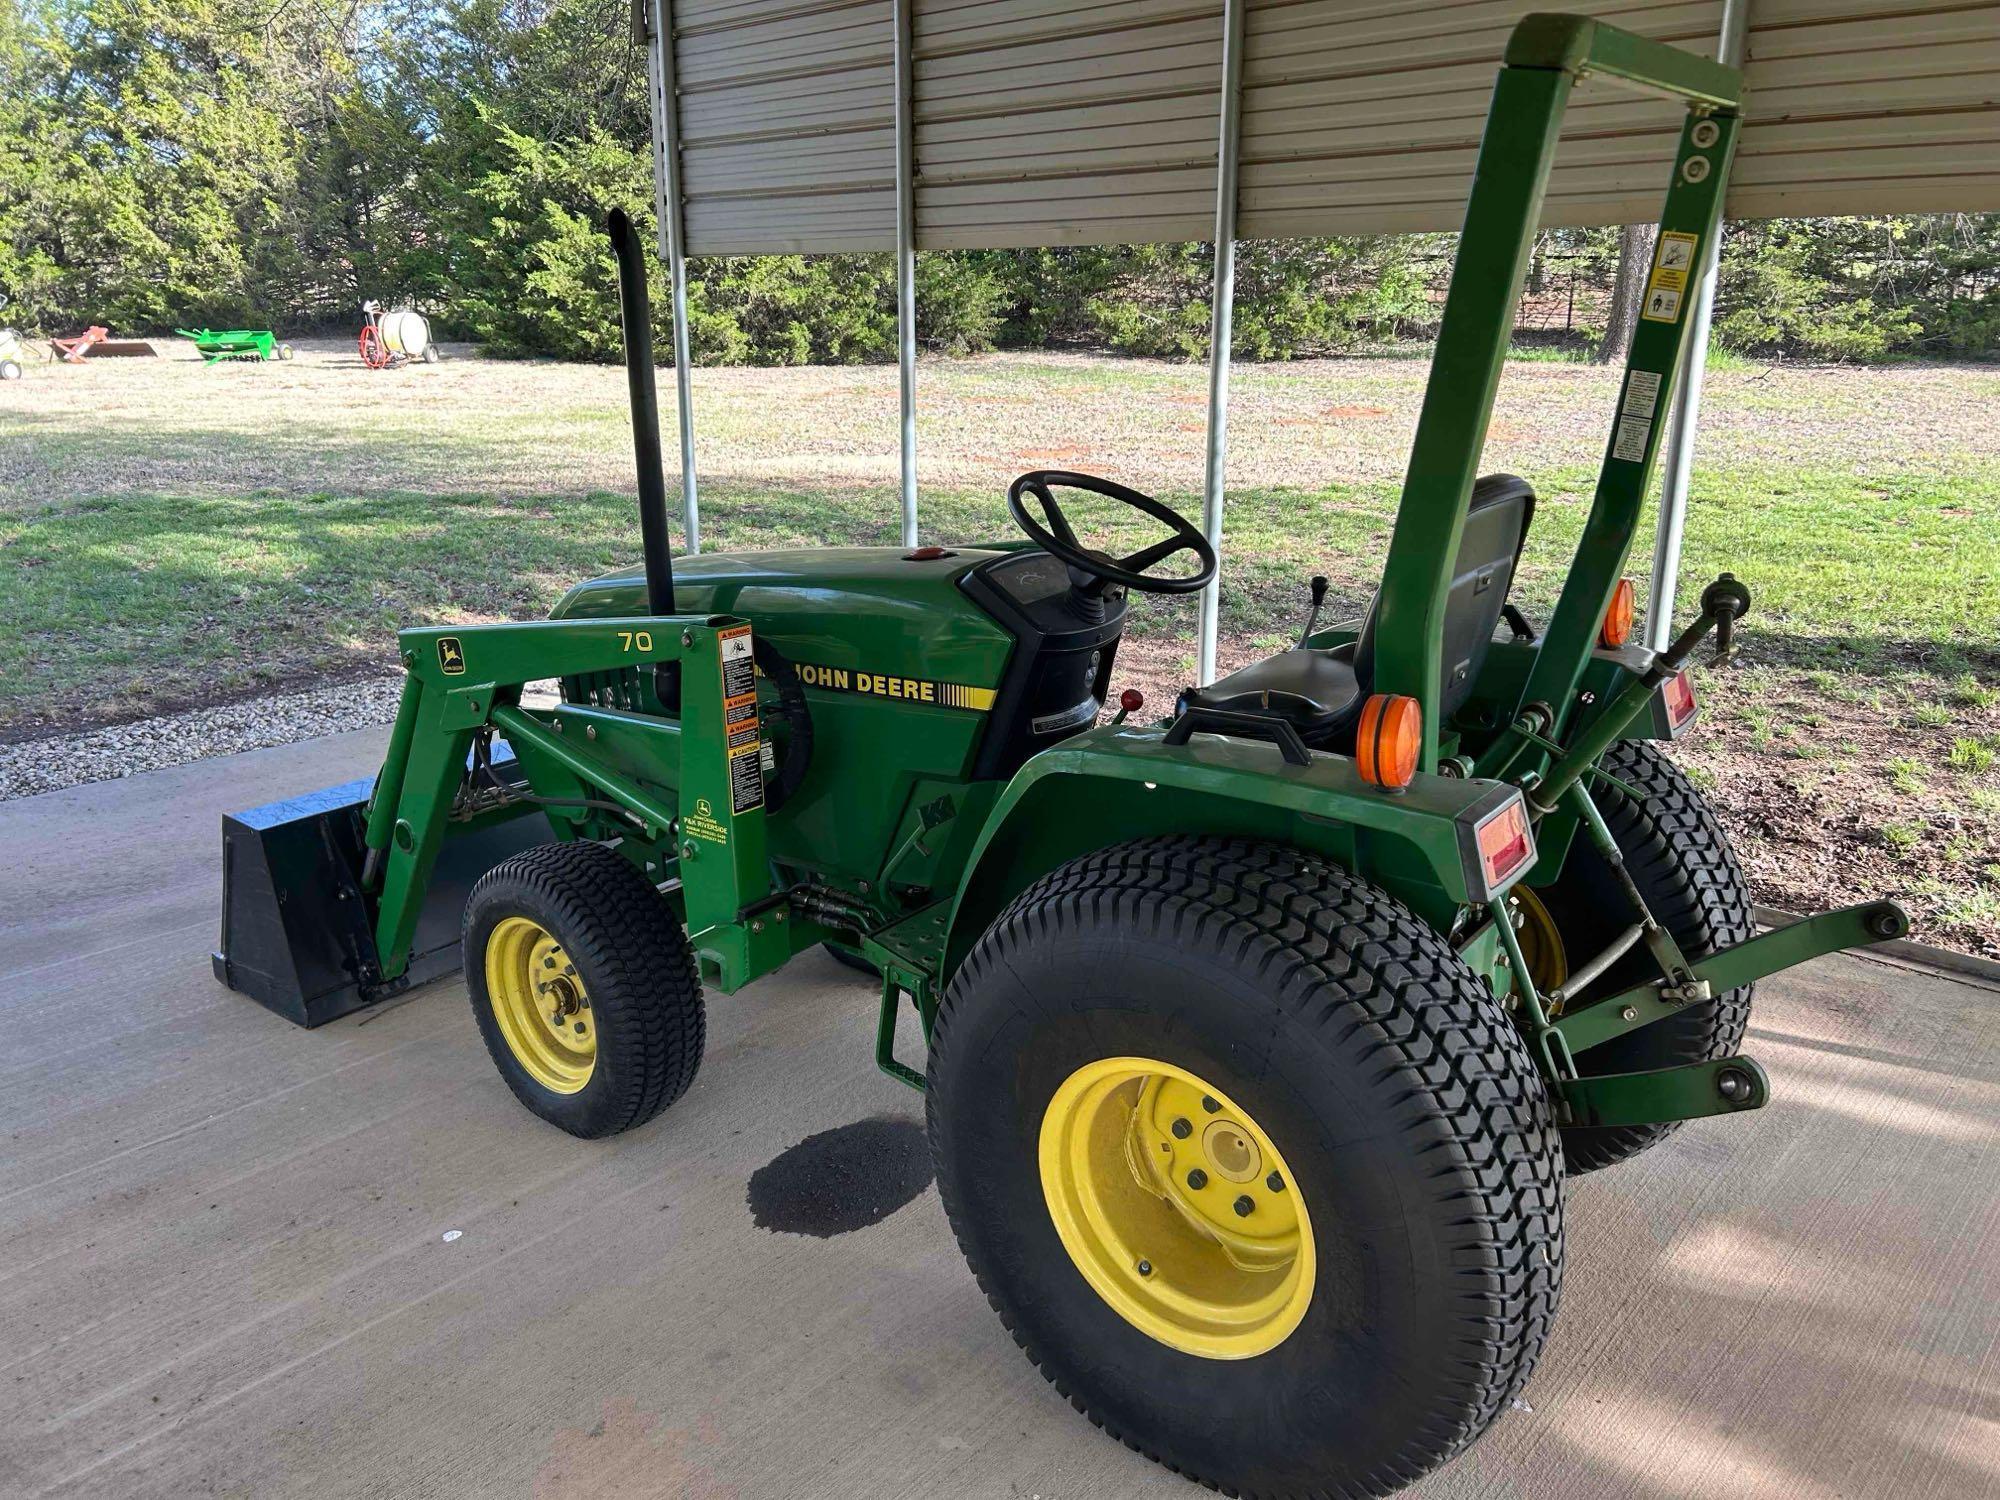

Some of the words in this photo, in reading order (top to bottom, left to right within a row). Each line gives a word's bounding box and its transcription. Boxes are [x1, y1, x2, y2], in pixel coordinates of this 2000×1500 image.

[728, 627, 751, 637] WARNING
[617, 631, 653, 652] 70
[856, 673, 934, 701] DEERE
[734, 695, 755, 705] WARNING
[735, 720, 757, 731] WARNING
[737, 745, 758, 755] CAUTION
